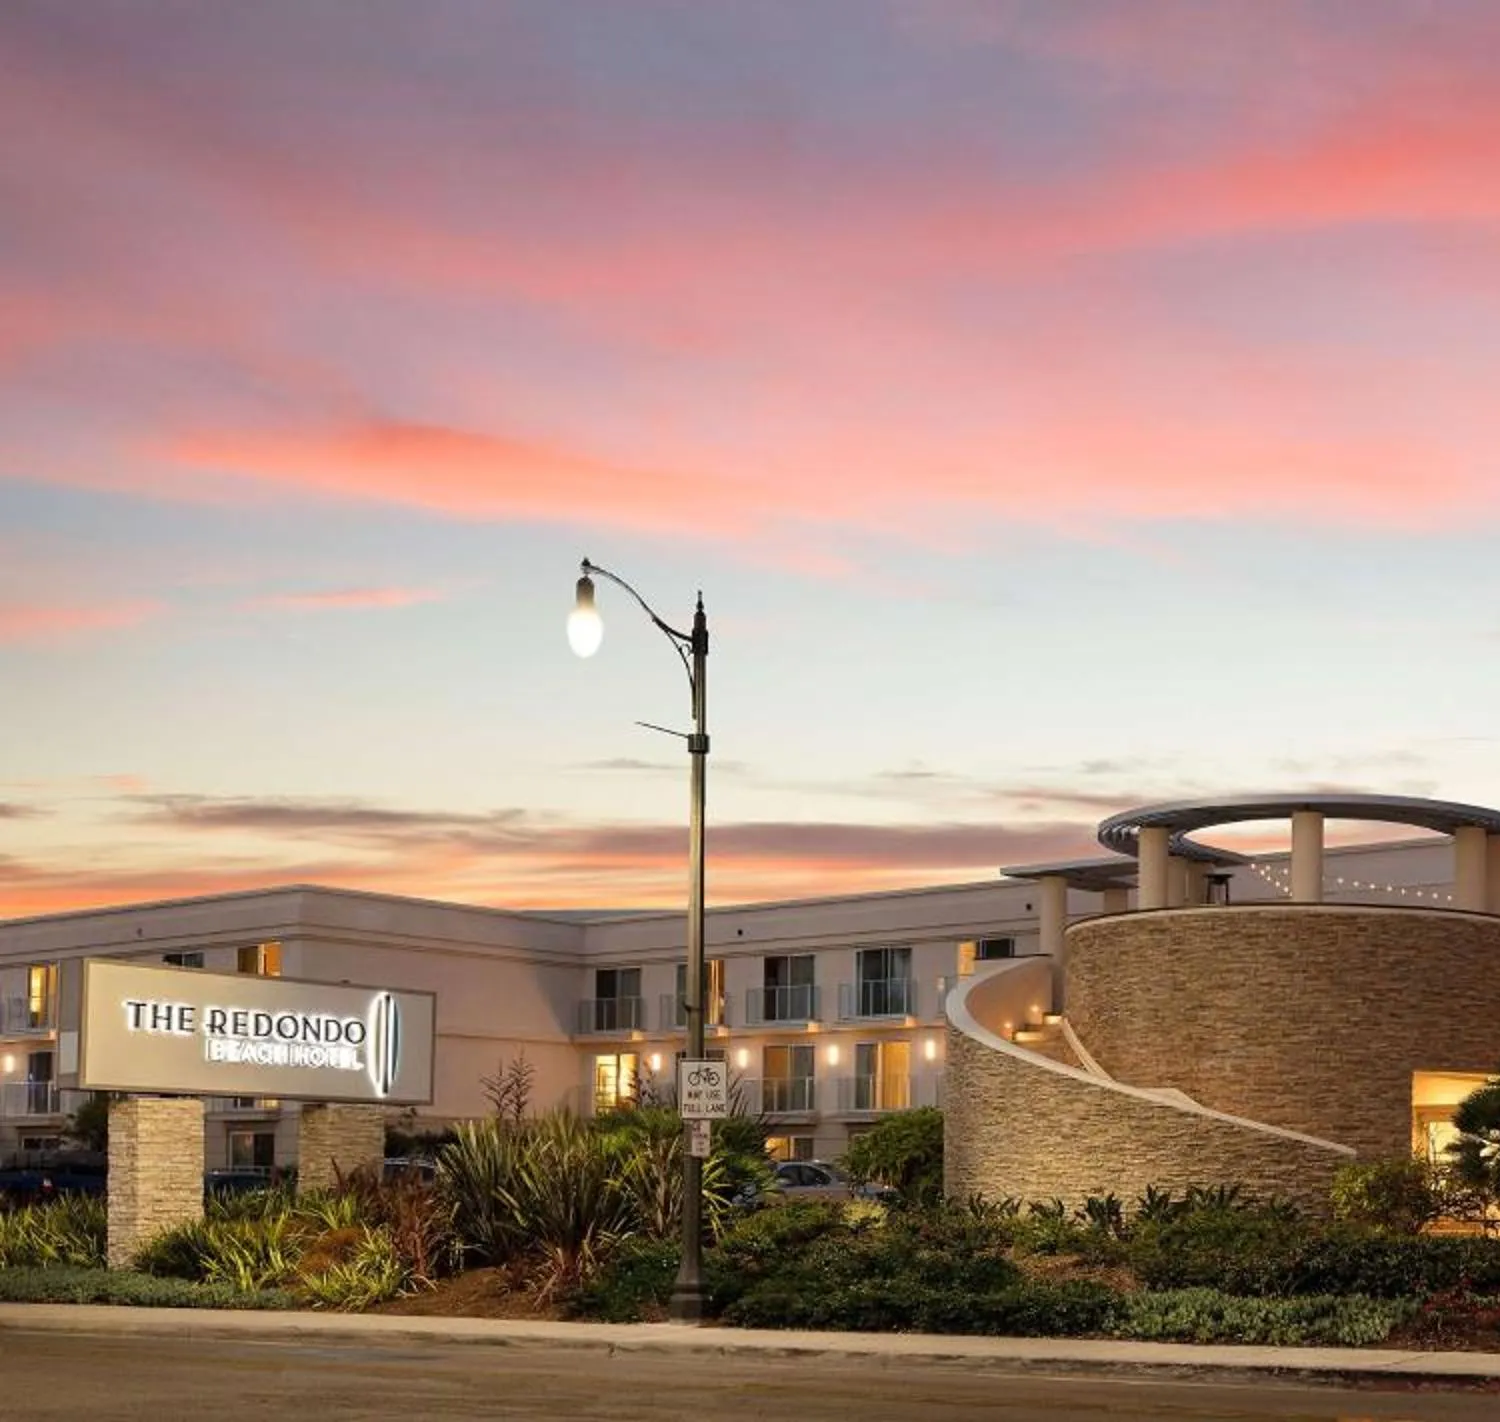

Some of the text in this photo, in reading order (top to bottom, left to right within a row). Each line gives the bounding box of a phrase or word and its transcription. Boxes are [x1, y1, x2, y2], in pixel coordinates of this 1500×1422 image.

[127, 1001, 367, 1044] THE REDONDO
[206, 1039, 365, 1070] BEACH HOTEL
